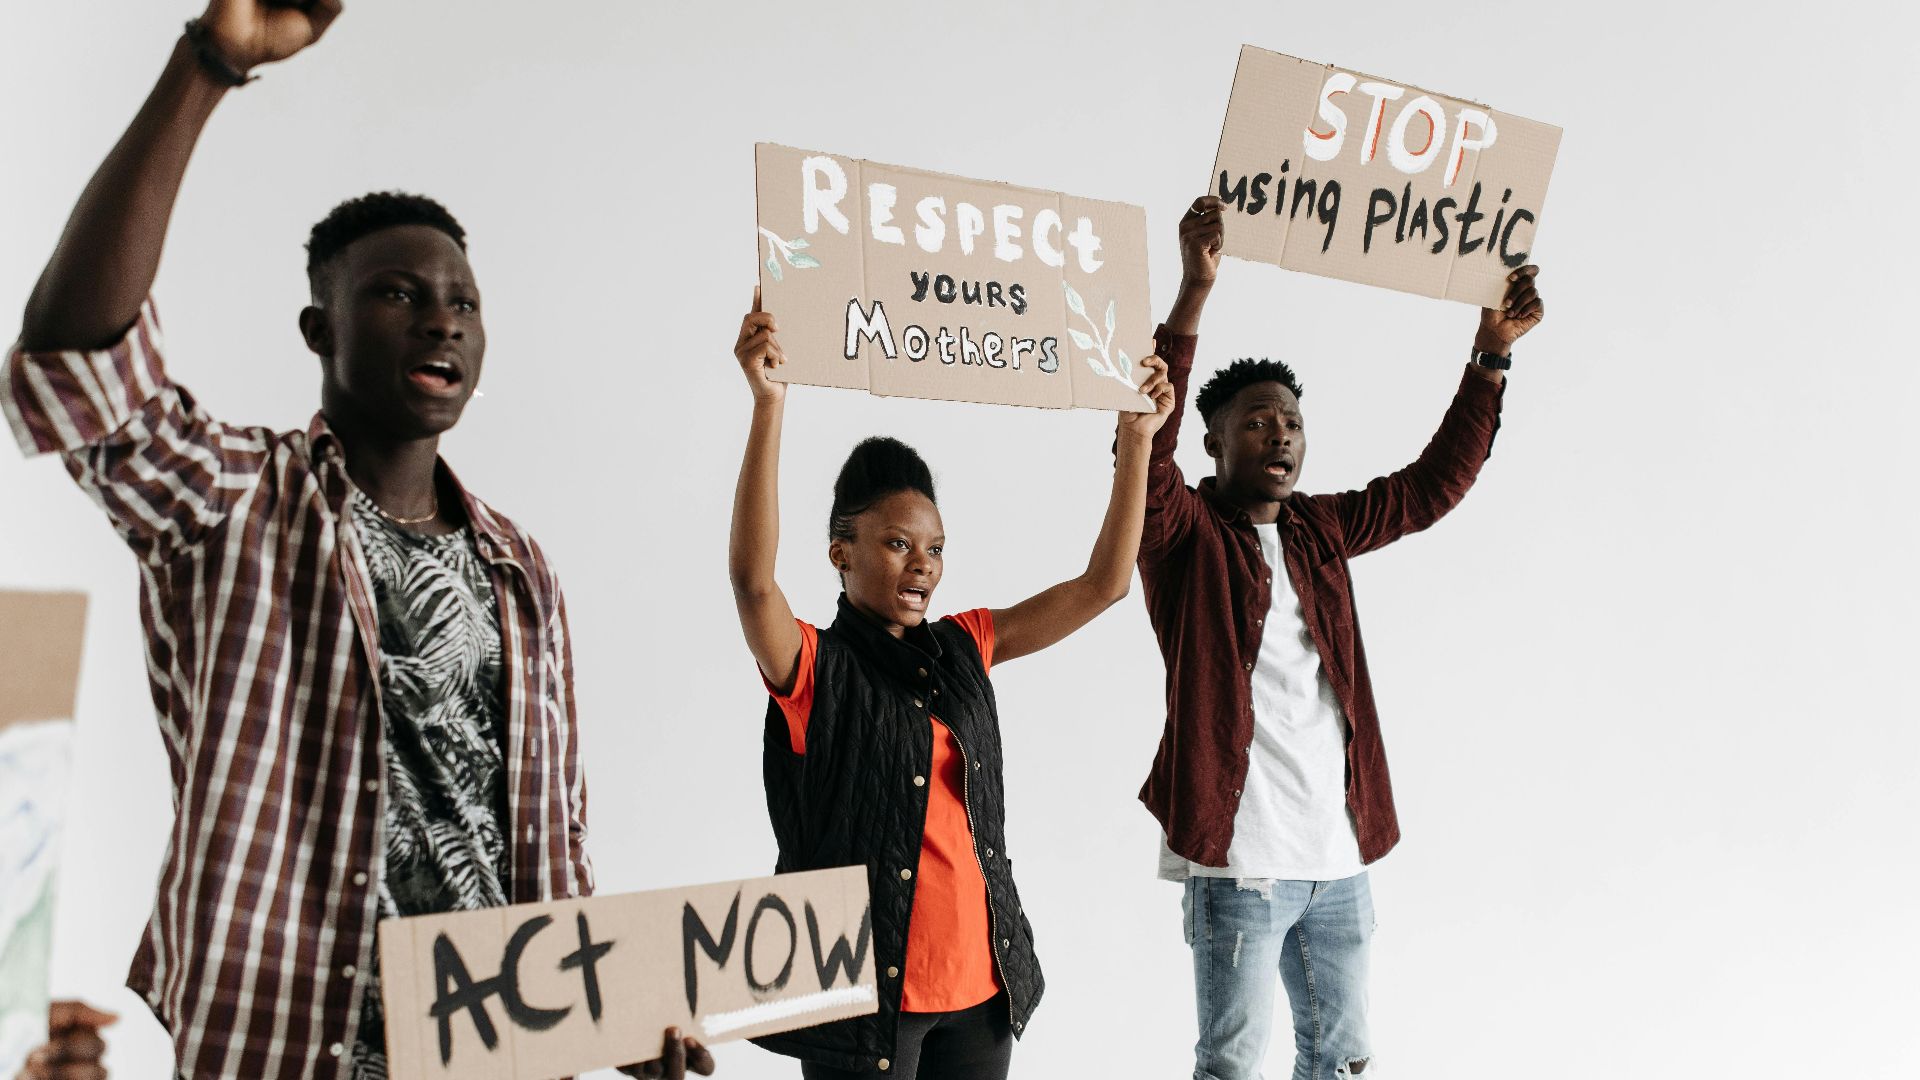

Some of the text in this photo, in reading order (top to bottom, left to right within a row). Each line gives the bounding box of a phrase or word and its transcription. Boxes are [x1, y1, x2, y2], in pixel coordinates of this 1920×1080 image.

[1303, 72, 1497, 188] STOP
[1218, 158, 1342, 255] using
[843, 297, 1061, 374] Mothers
[681, 884, 873, 1019] NOW
